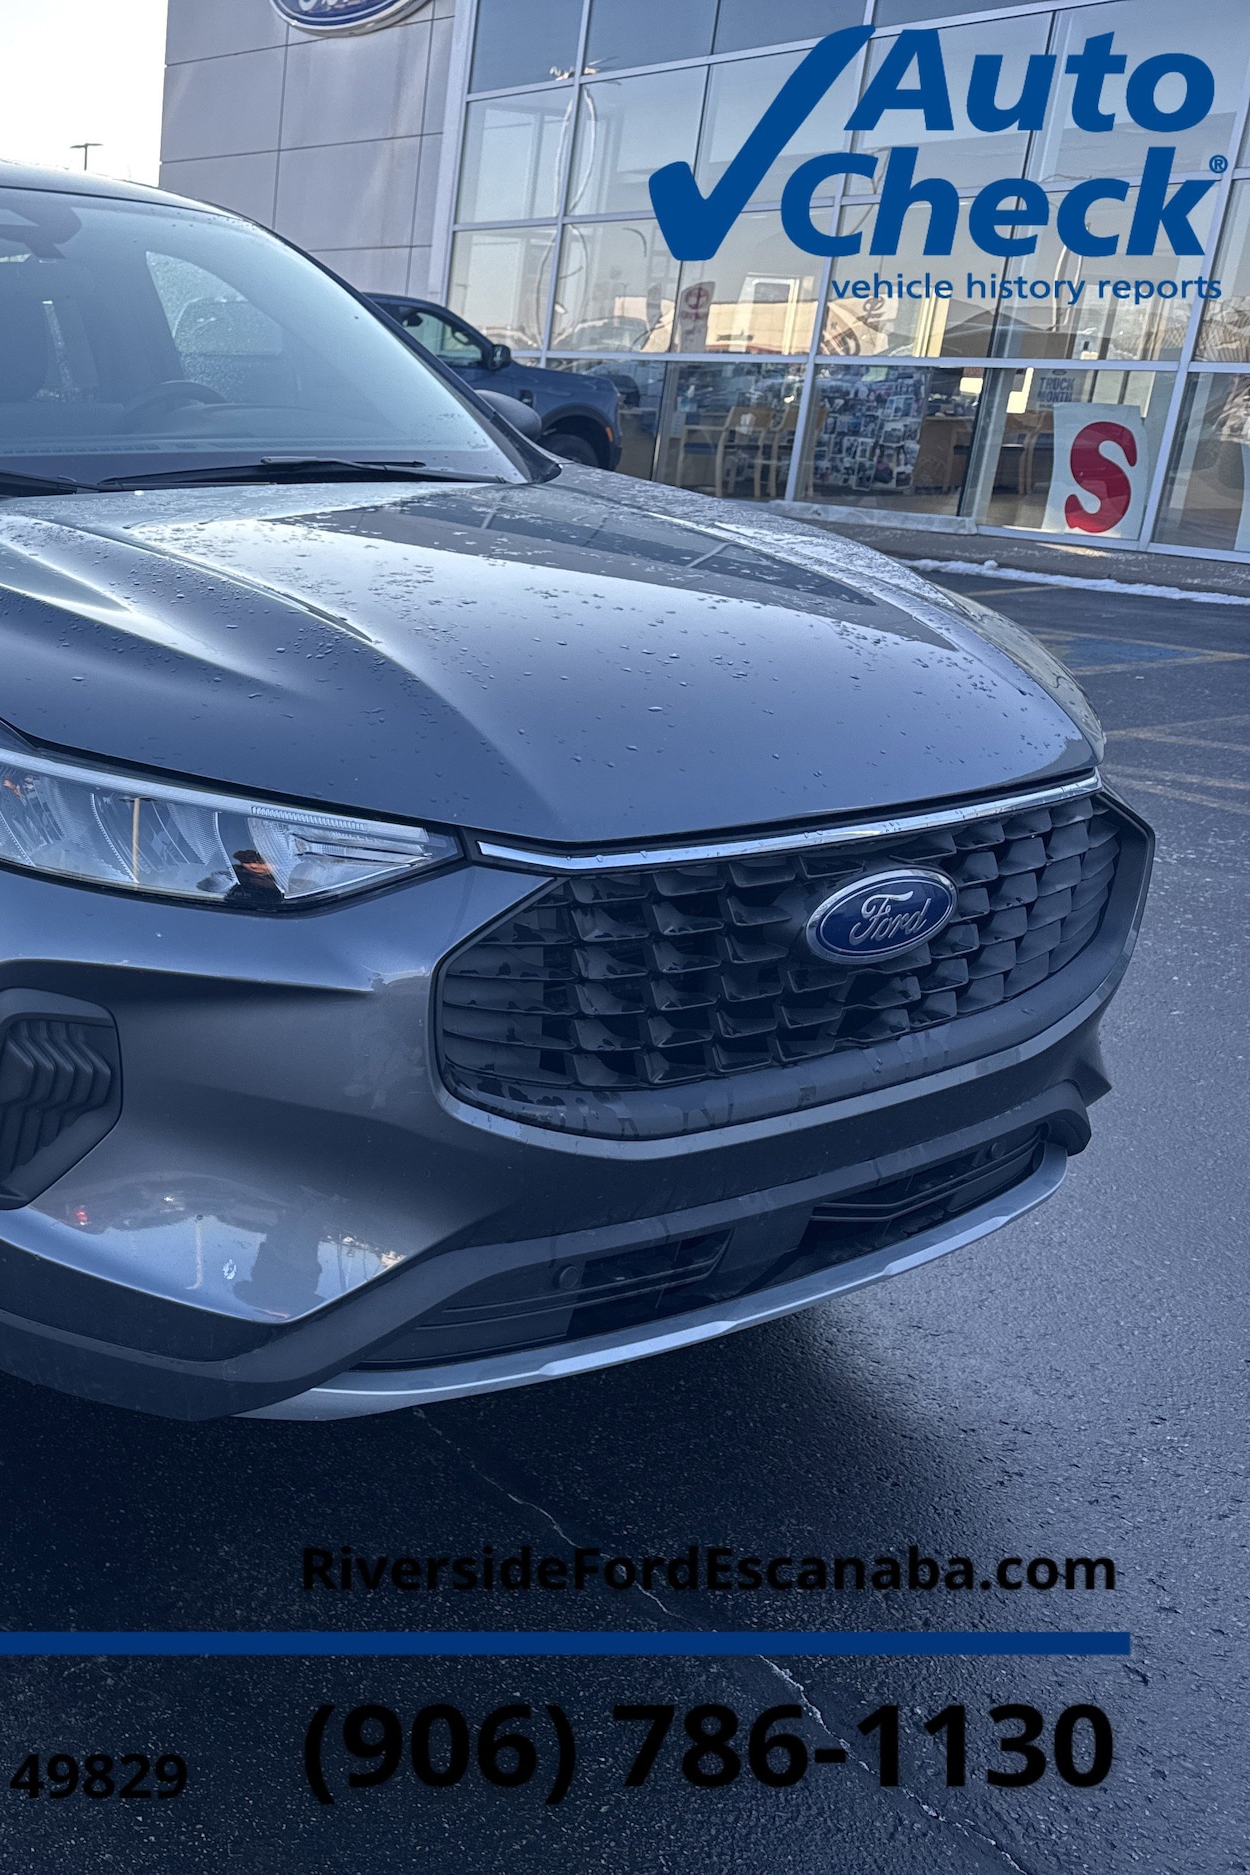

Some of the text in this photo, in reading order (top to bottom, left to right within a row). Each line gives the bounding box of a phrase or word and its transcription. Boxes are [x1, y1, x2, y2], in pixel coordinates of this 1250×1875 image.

[1039, 377, 1076, 391] TRUCK
[1064, 421, 1138, 534] S
[849, 890, 932, 946] Ford
